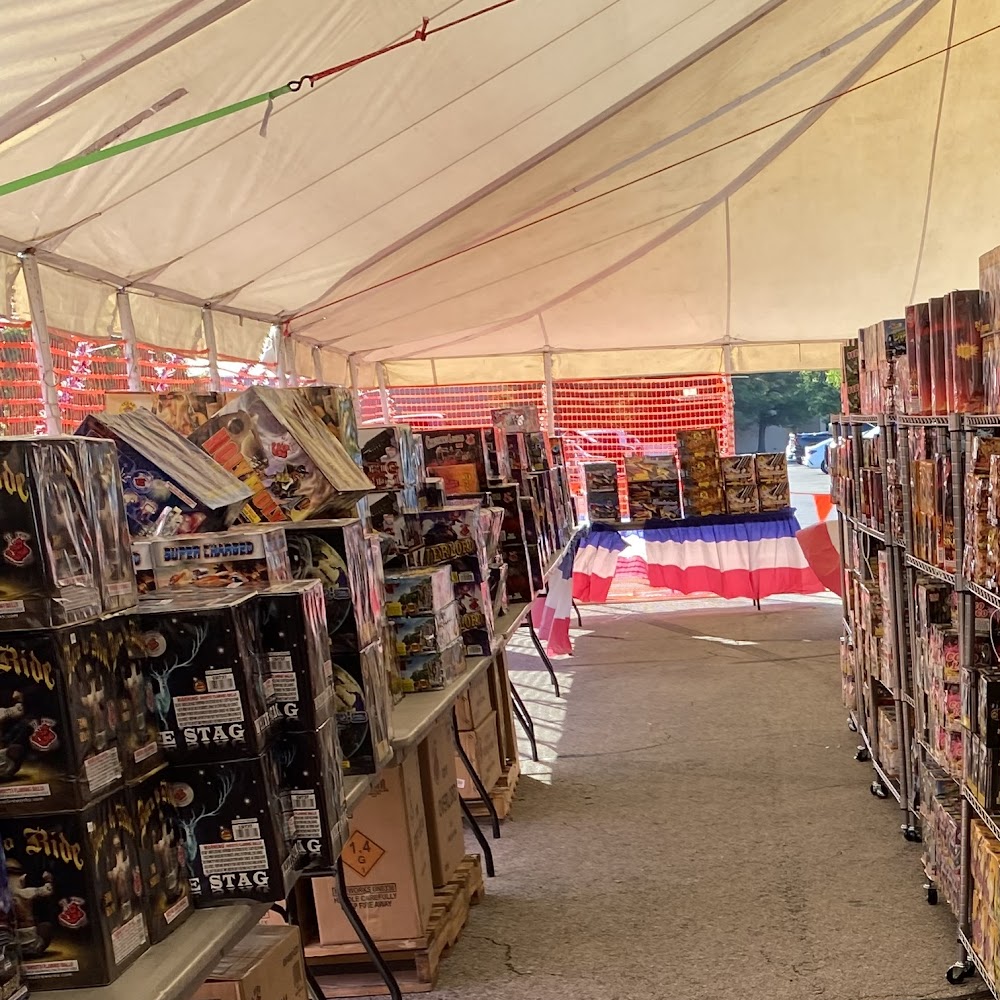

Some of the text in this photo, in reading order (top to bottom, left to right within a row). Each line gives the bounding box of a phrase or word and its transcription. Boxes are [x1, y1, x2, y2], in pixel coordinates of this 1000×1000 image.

[164, 541, 254, 562] SUPER CHARGED
[184, 723, 246, 743] STAG
[23, 827, 84, 871] Ride
[349, 841, 371, 854] 1.4
[357, 855, 366, 864] G
[209, 871, 270, 889] STAG
